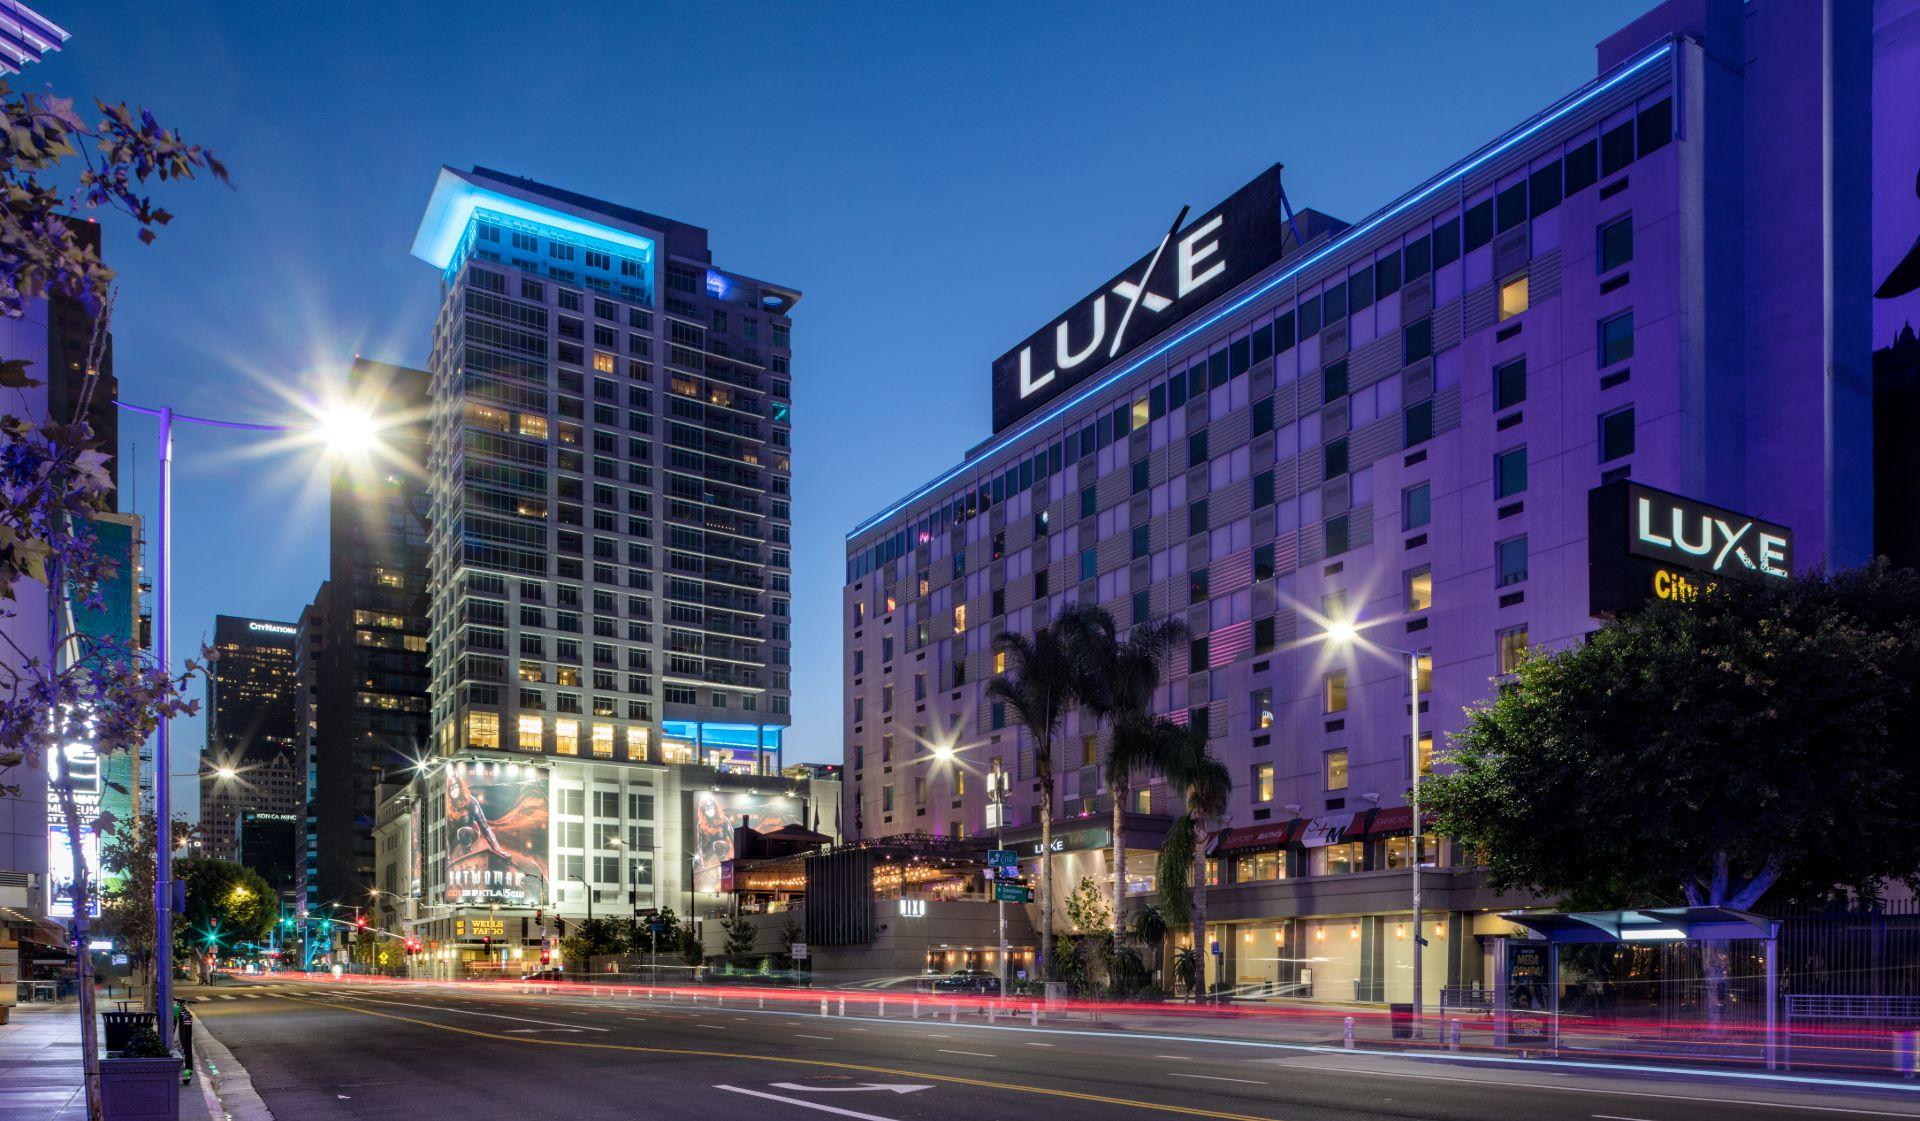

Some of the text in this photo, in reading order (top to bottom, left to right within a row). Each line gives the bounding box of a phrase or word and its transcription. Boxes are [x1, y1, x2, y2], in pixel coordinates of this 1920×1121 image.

[1020, 205, 1226, 399] LUXE
[1638, 496, 1788, 578] LUXE
[471, 920, 504, 928] WELLS
